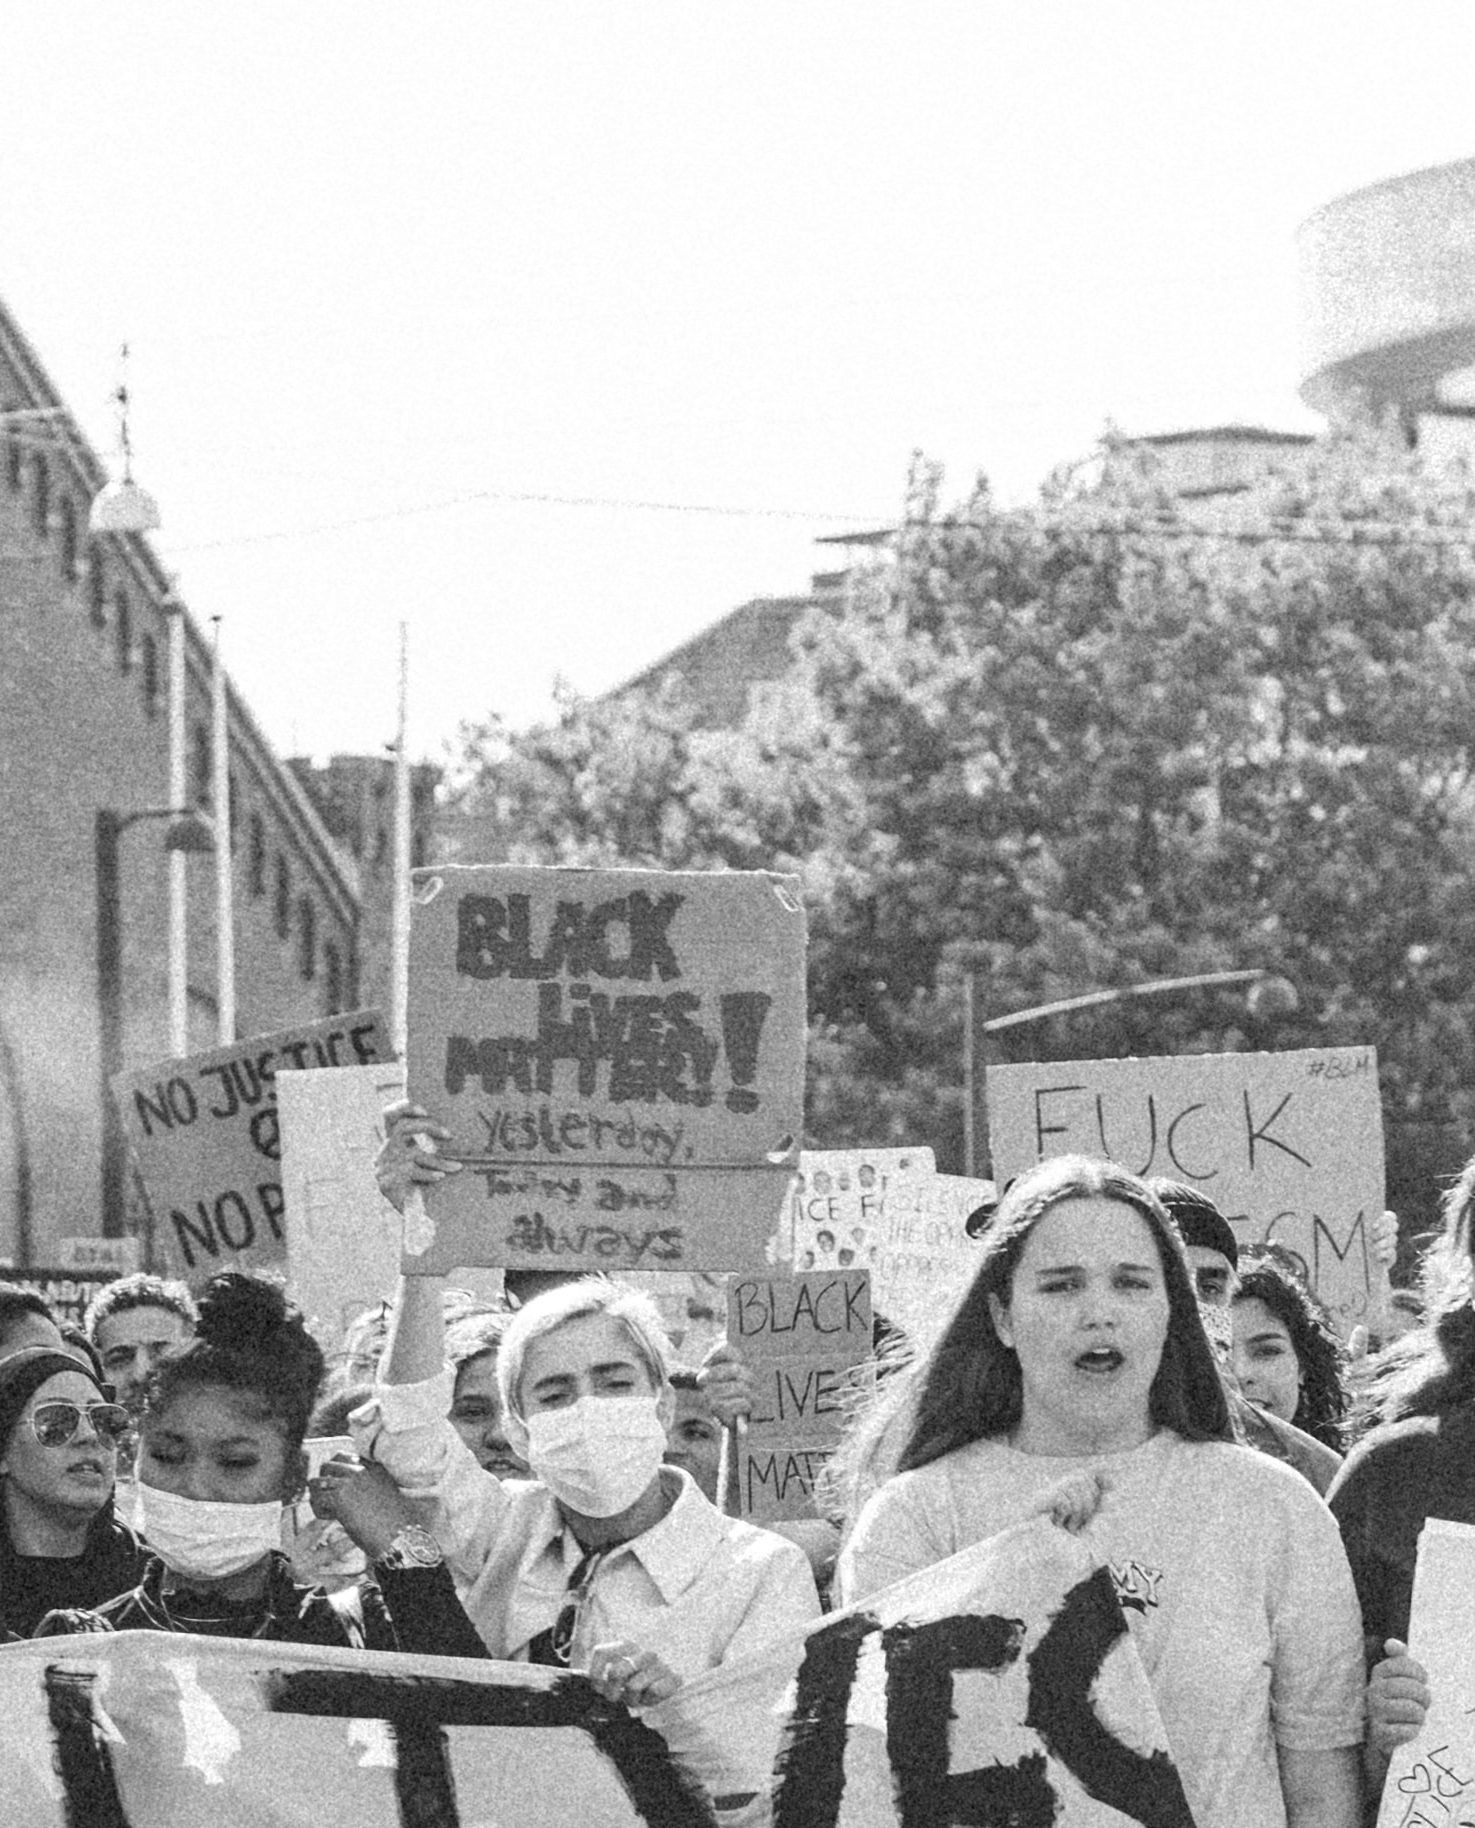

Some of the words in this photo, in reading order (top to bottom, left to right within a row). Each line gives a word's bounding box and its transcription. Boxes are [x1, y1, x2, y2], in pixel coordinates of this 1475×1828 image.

[456, 889, 686, 982] BLACK
[133, 1077, 199, 1136] NO
[1035, 1085, 1313, 1180] FUCK
[170, 1189, 255, 1267] NO
[735, 1280, 869, 1337] BLACK
[747, 1369, 847, 1424] LIVE
